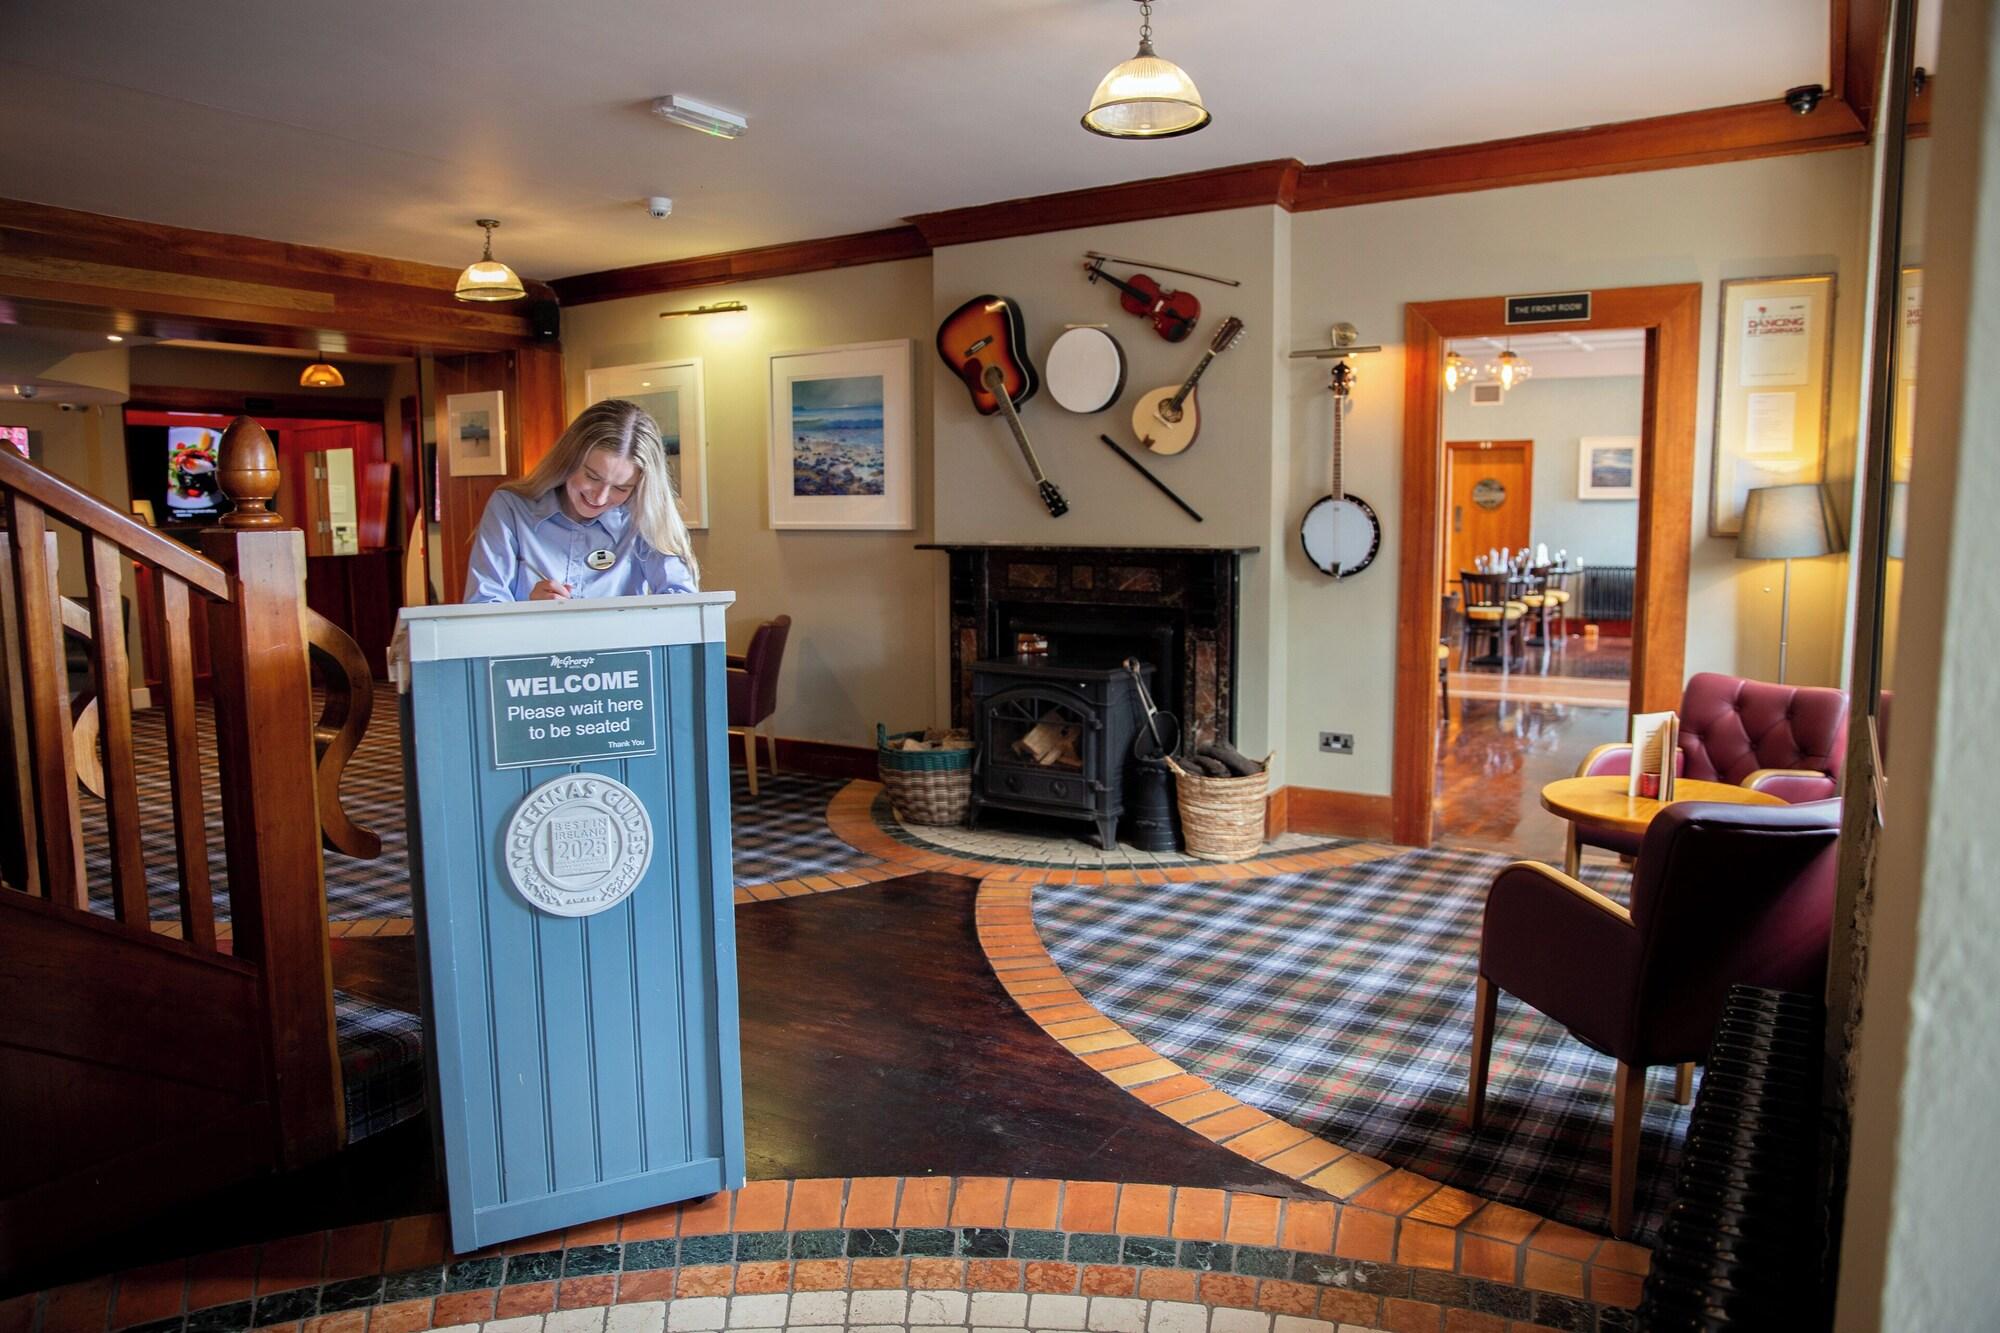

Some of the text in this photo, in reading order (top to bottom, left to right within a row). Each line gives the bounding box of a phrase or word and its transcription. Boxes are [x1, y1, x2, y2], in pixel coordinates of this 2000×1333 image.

[1514, 303, 1583, 314] THE FRONT ROOM
[1748, 317, 1804, 329] DANCING
[550, 655, 595, 668] McGrory's
[506, 670, 639, 697] WELCOME
[507, 699, 644, 721] Please wait here
[528, 717, 630, 740] to be seated
[631, 739, 645, 747] You
[555, 817, 607, 831] BEST IN
[601, 788, 647, 855] GUIDES
[555, 827, 607, 840] IRELAND
